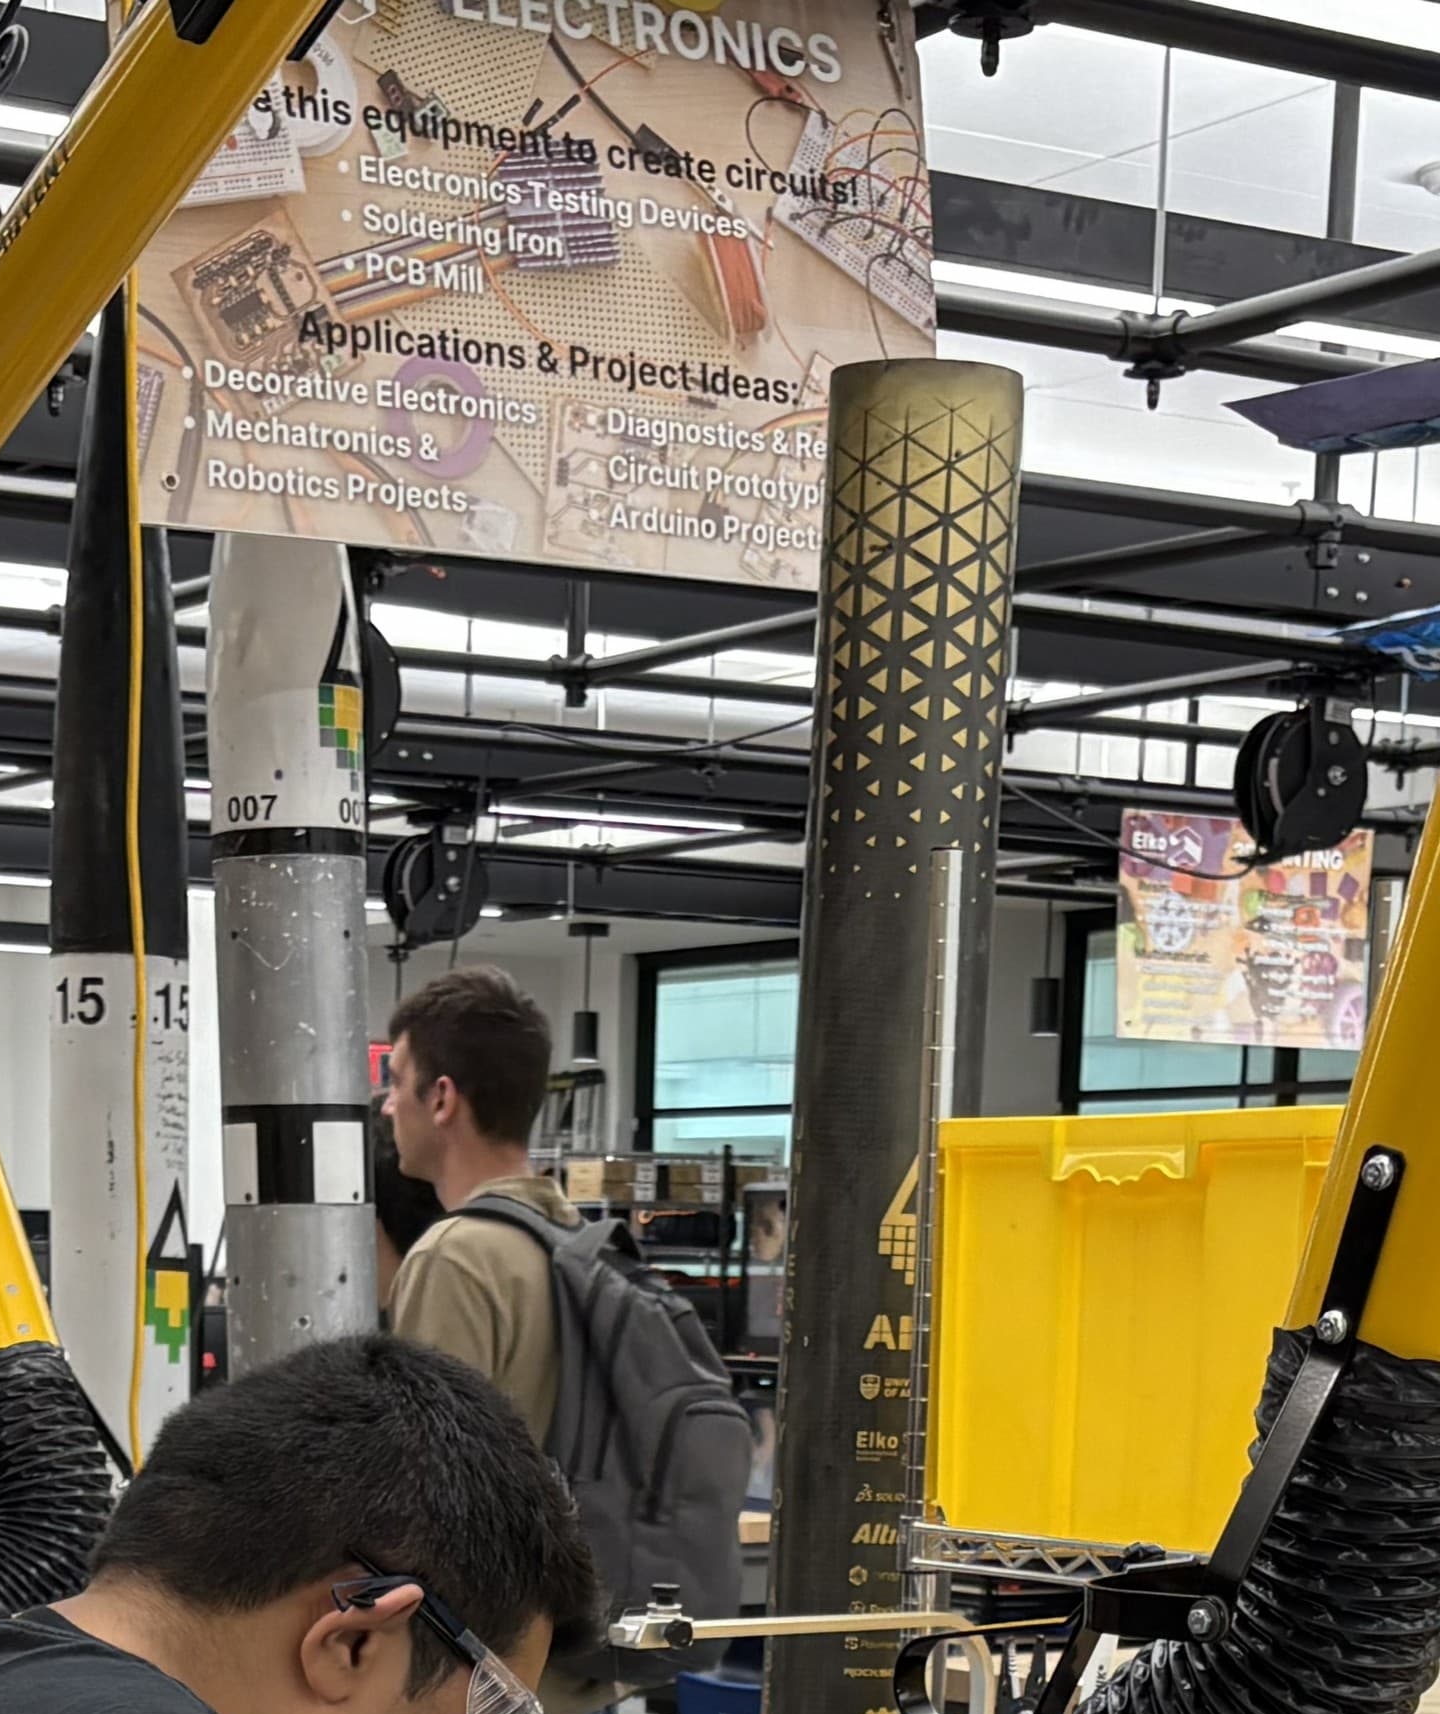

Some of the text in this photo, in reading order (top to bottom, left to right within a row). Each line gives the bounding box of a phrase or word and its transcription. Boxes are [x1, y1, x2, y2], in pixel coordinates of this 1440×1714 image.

[283, 86, 353, 126] this
[363, 104, 553, 157] equipment
[562, 130, 597, 165] to
[607, 144, 717, 183] create
[725, 157, 860, 207] circuits!
[359, 155, 750, 241] Electronics Testing Devices
[363, 203, 564, 259] Soldering Iron
[365, 253, 485, 295] PCB Mill
[298, 311, 801, 405] Applications & Project Ideas:
[204, 360, 538, 425] Decorative Electronics
[206, 408, 440, 462] Mechatronics &
[607, 407, 766, 453] Diagnostics
[772, 428, 796, 456] &
[207, 459, 469, 512] Robotics Projects
[608, 455, 700, 491] Circuit
[609, 501, 718, 540] Arduino
[228, 794, 278, 823] 007
[855, 1430, 899, 1449] Elko
